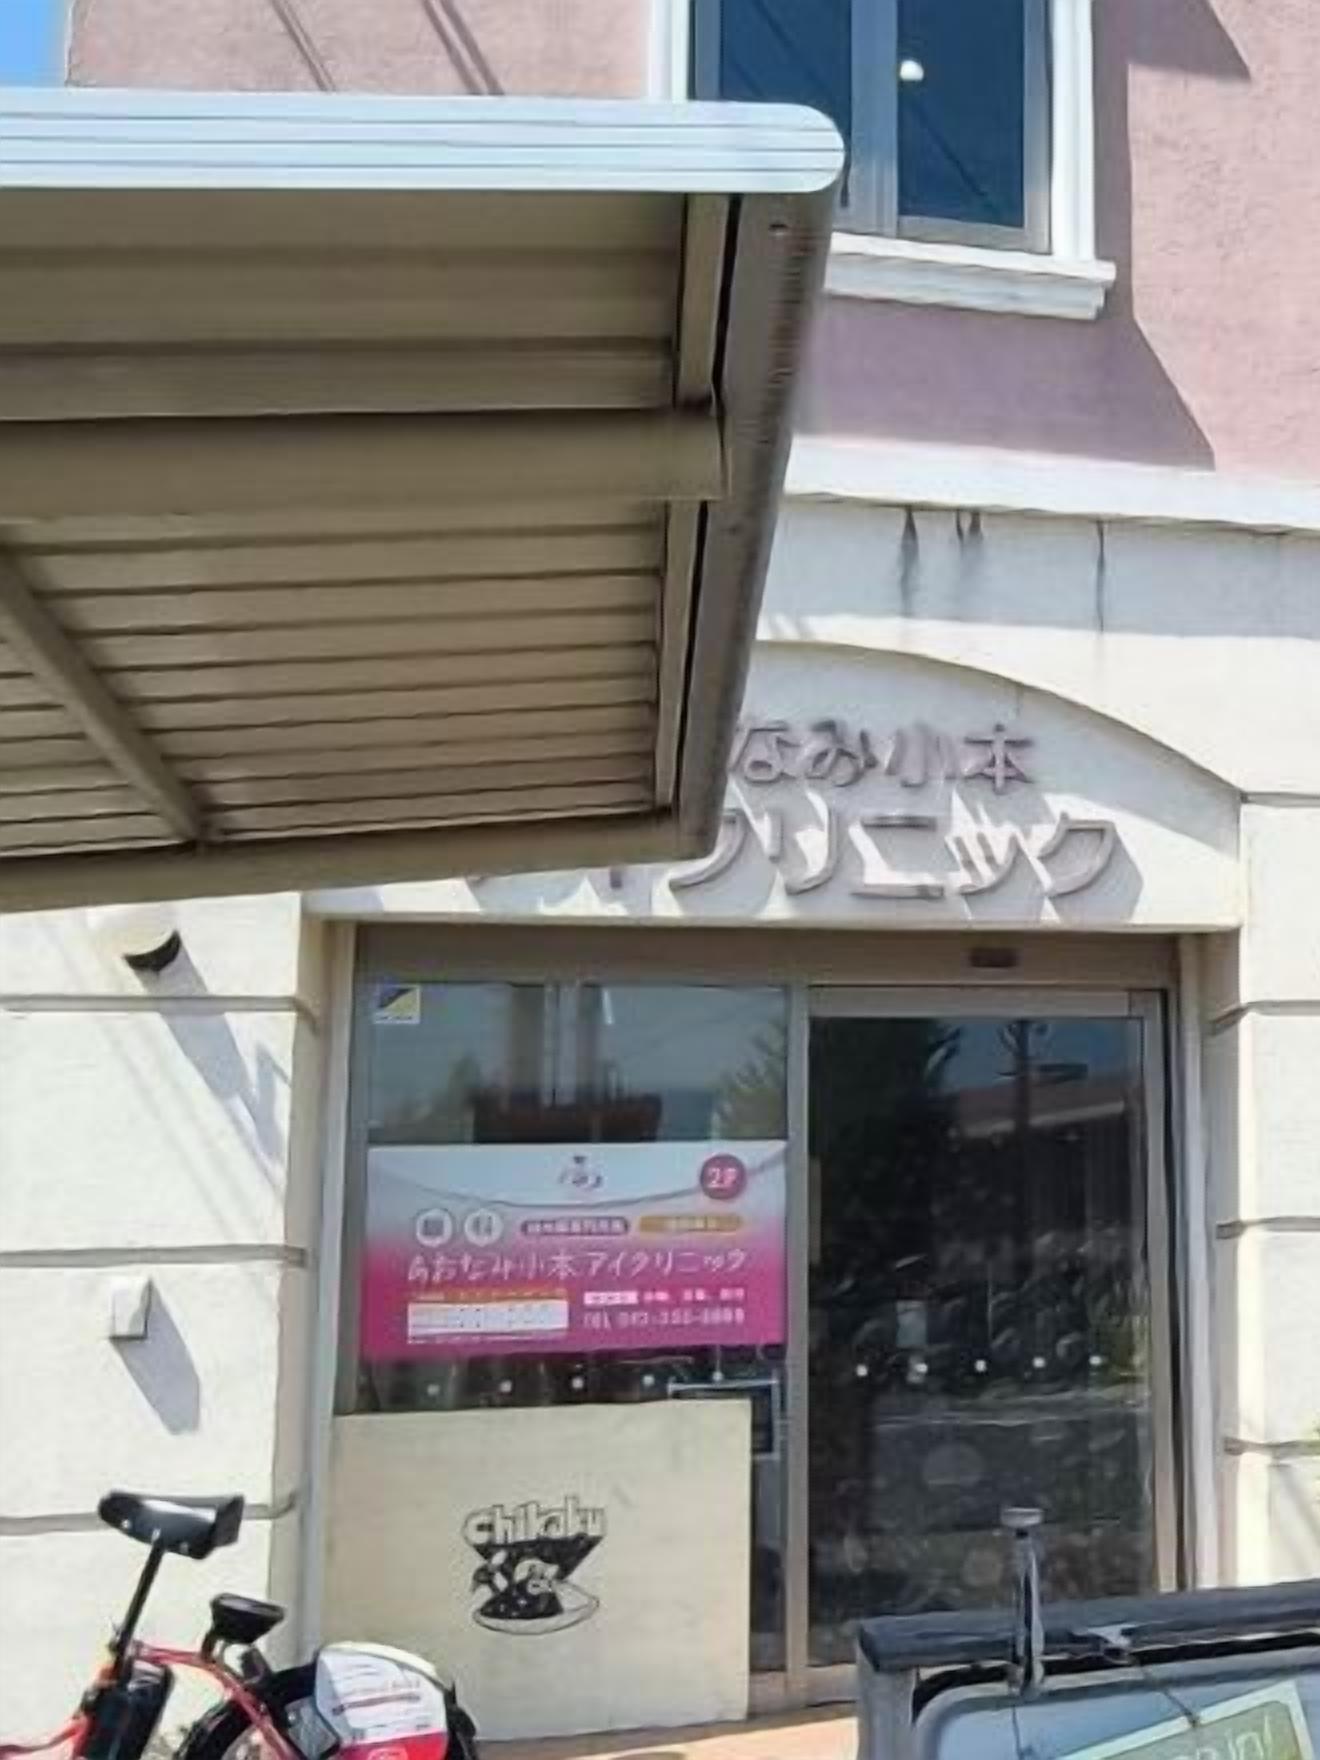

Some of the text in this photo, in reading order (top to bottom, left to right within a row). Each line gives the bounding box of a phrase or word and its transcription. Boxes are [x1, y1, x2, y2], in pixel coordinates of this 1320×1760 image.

[608, 808, 1117, 899] クリニック
